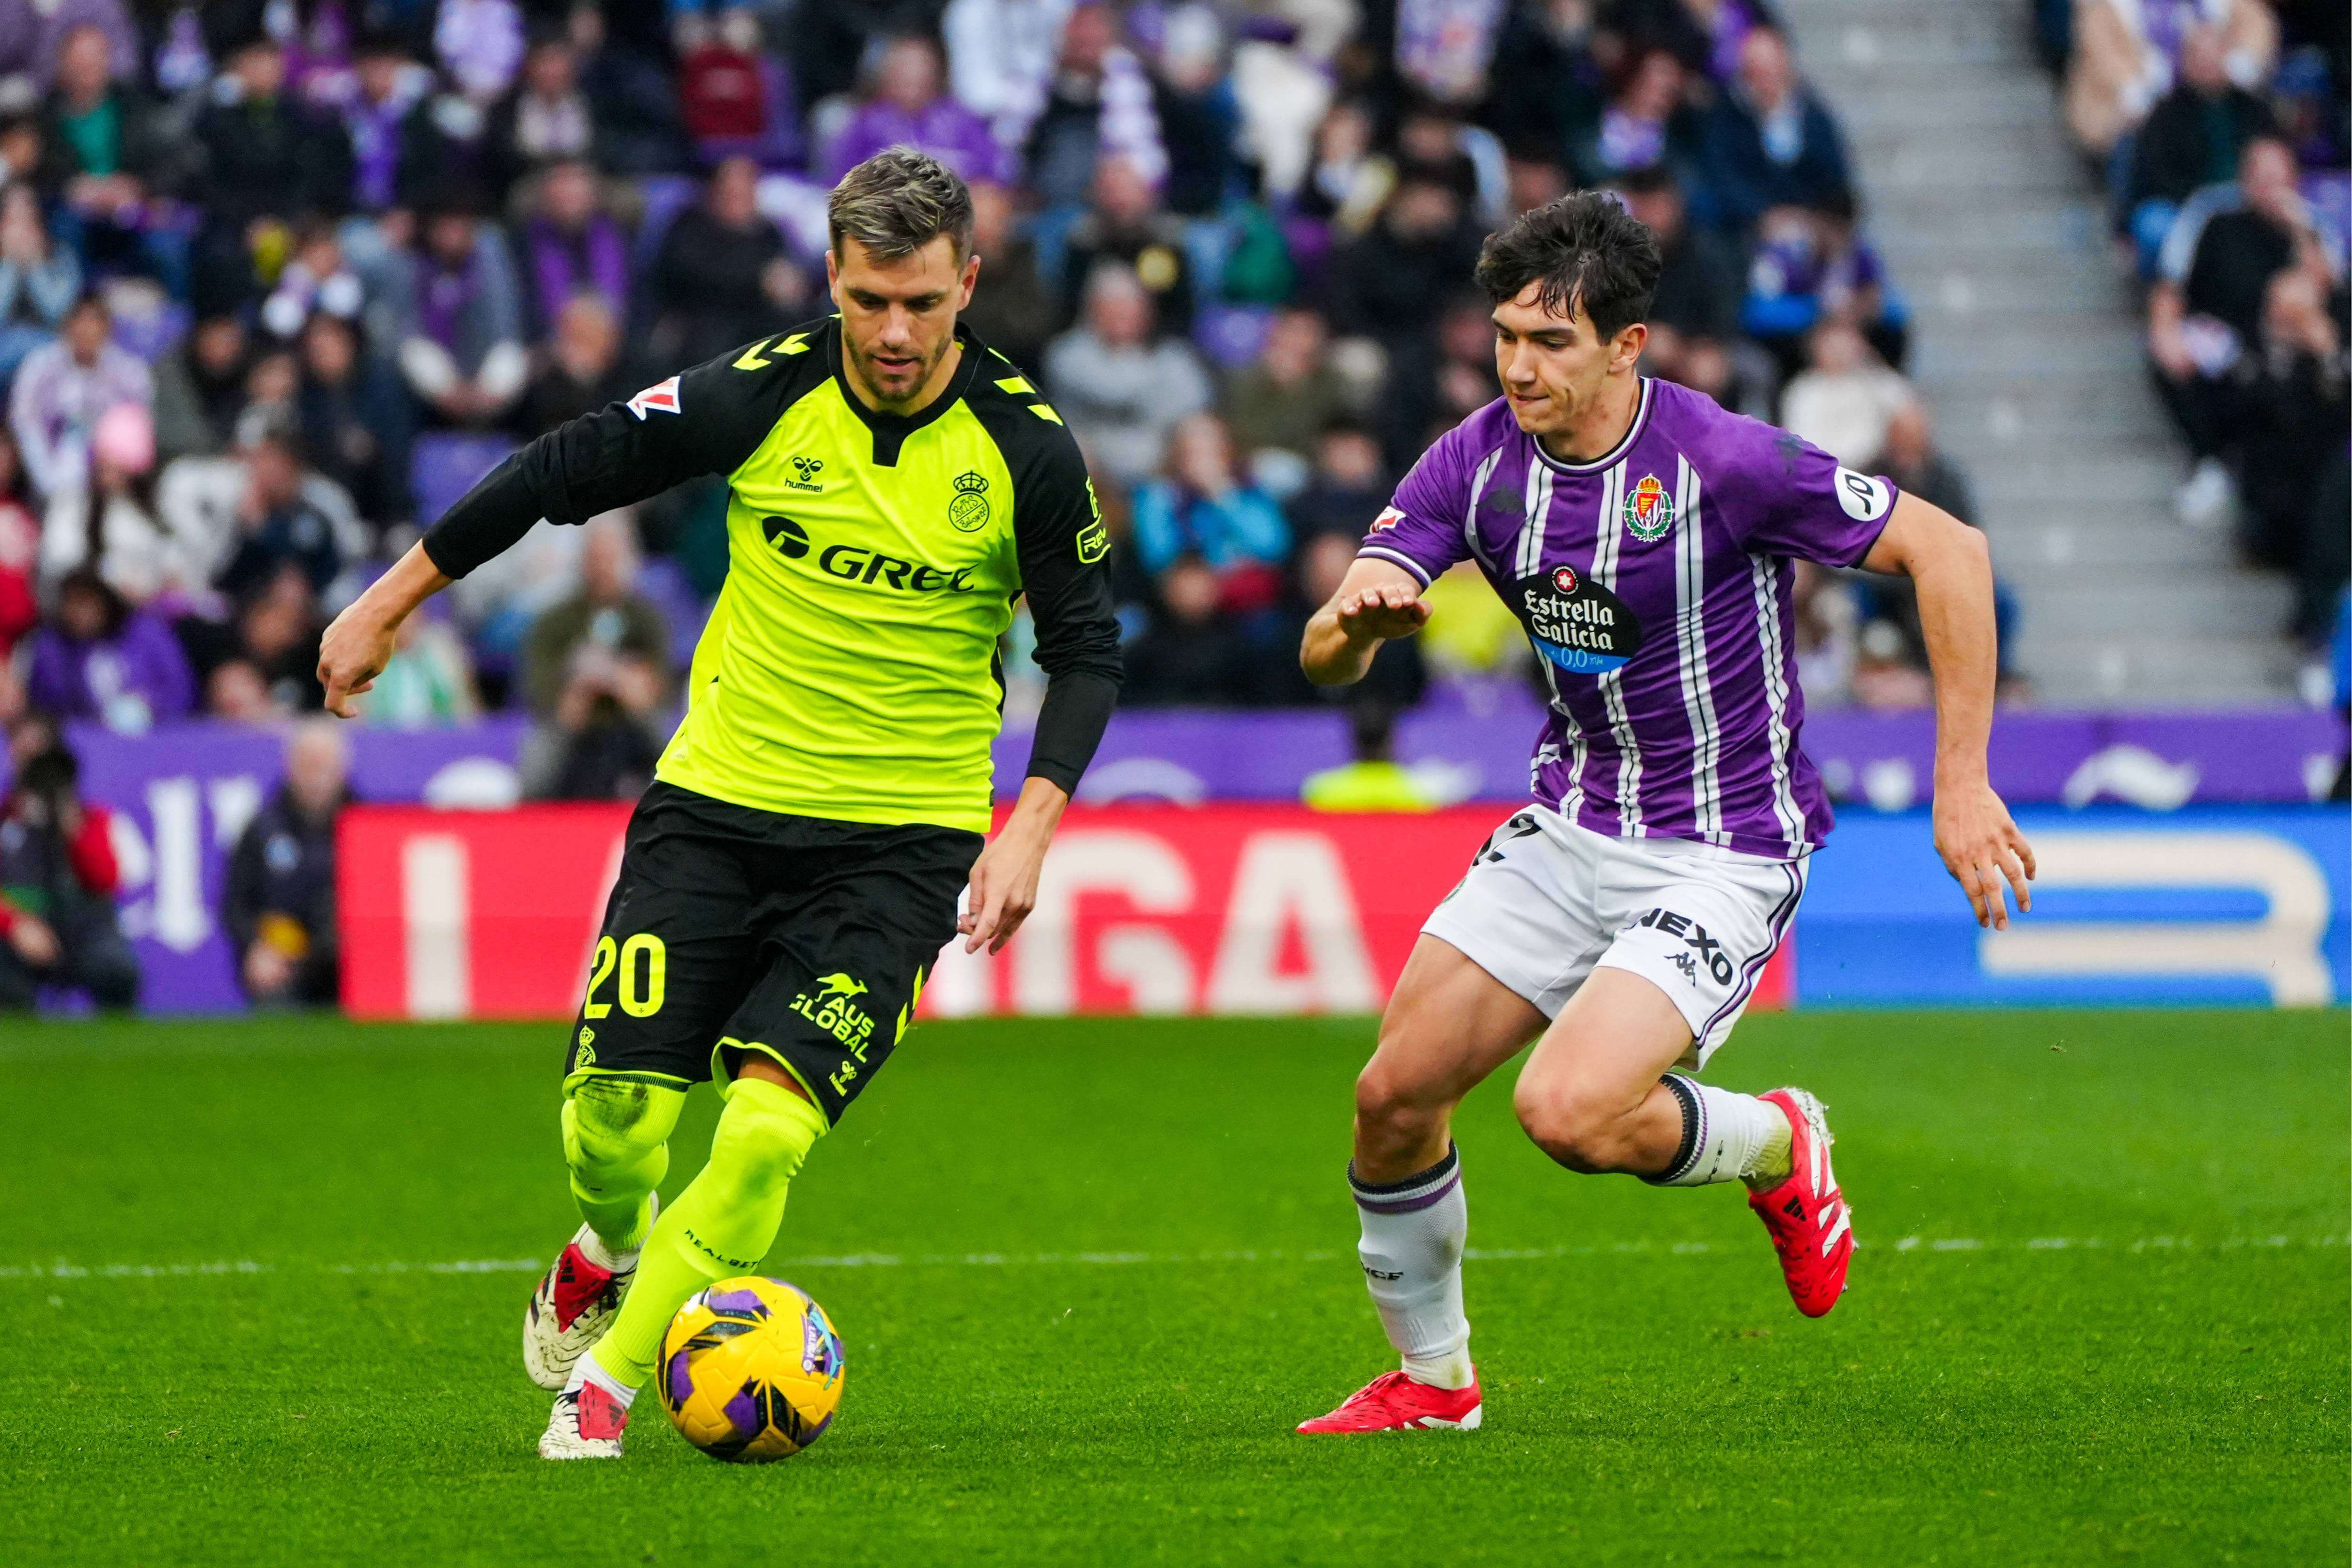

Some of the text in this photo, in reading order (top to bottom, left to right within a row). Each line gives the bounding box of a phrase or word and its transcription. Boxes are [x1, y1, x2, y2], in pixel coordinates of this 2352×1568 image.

[785, 477, 823, 493] hummel
[819, 545, 979, 592] GREE
[1524, 589, 1615, 627] Estrella
[1532, 614, 1614, 651] Galicia
[1561, 647, 1588, 668] 0,0
[584, 933, 666, 1019] 20
[789, 994, 868, 1063] GLOBAL
[825, 996, 875, 1038] AUS
